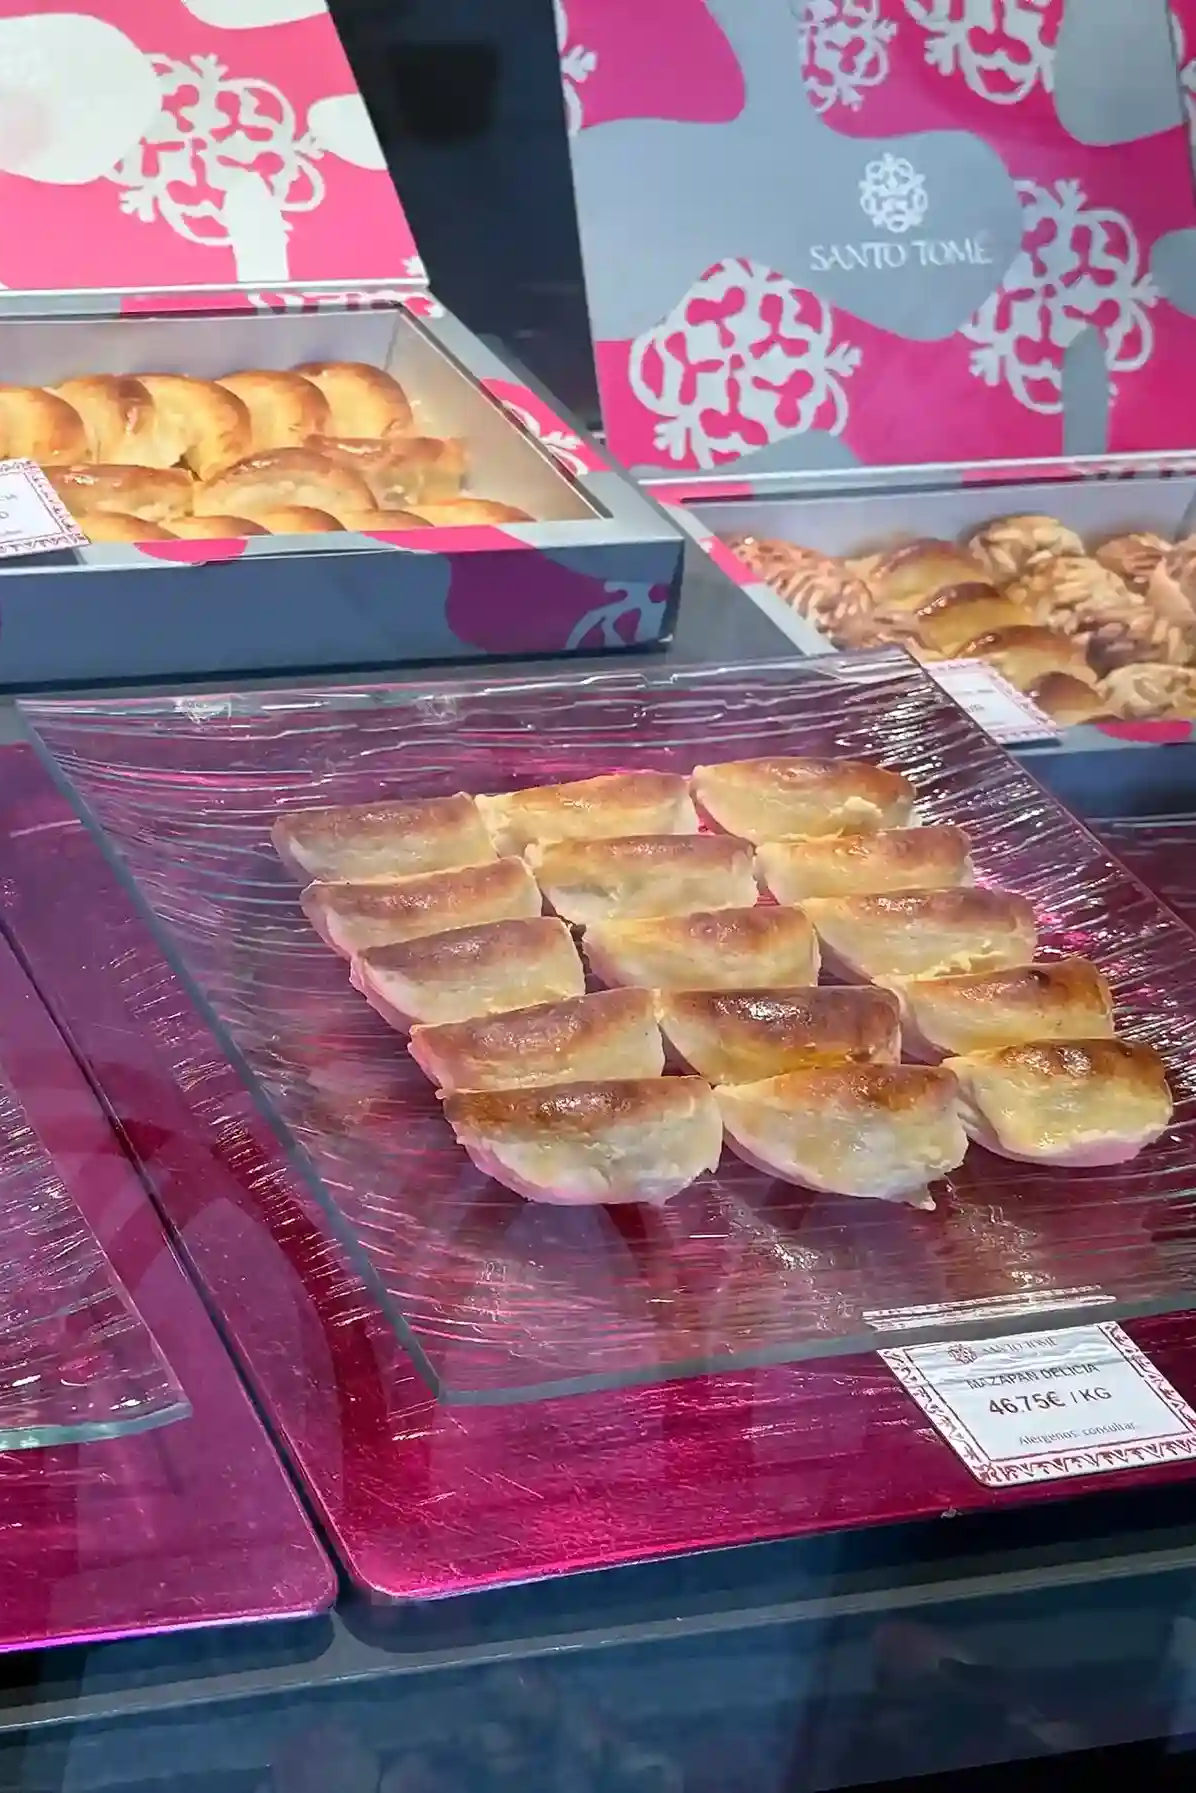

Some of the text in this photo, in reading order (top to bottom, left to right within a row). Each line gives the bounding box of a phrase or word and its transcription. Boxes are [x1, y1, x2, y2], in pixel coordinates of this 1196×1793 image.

[809, 243, 905, 271] SANTO
[1040, 1363, 1101, 1380] DELICIA
[988, 1390, 1066, 1416] 46.75€
[1079, 1386, 1113, 1402] KG
